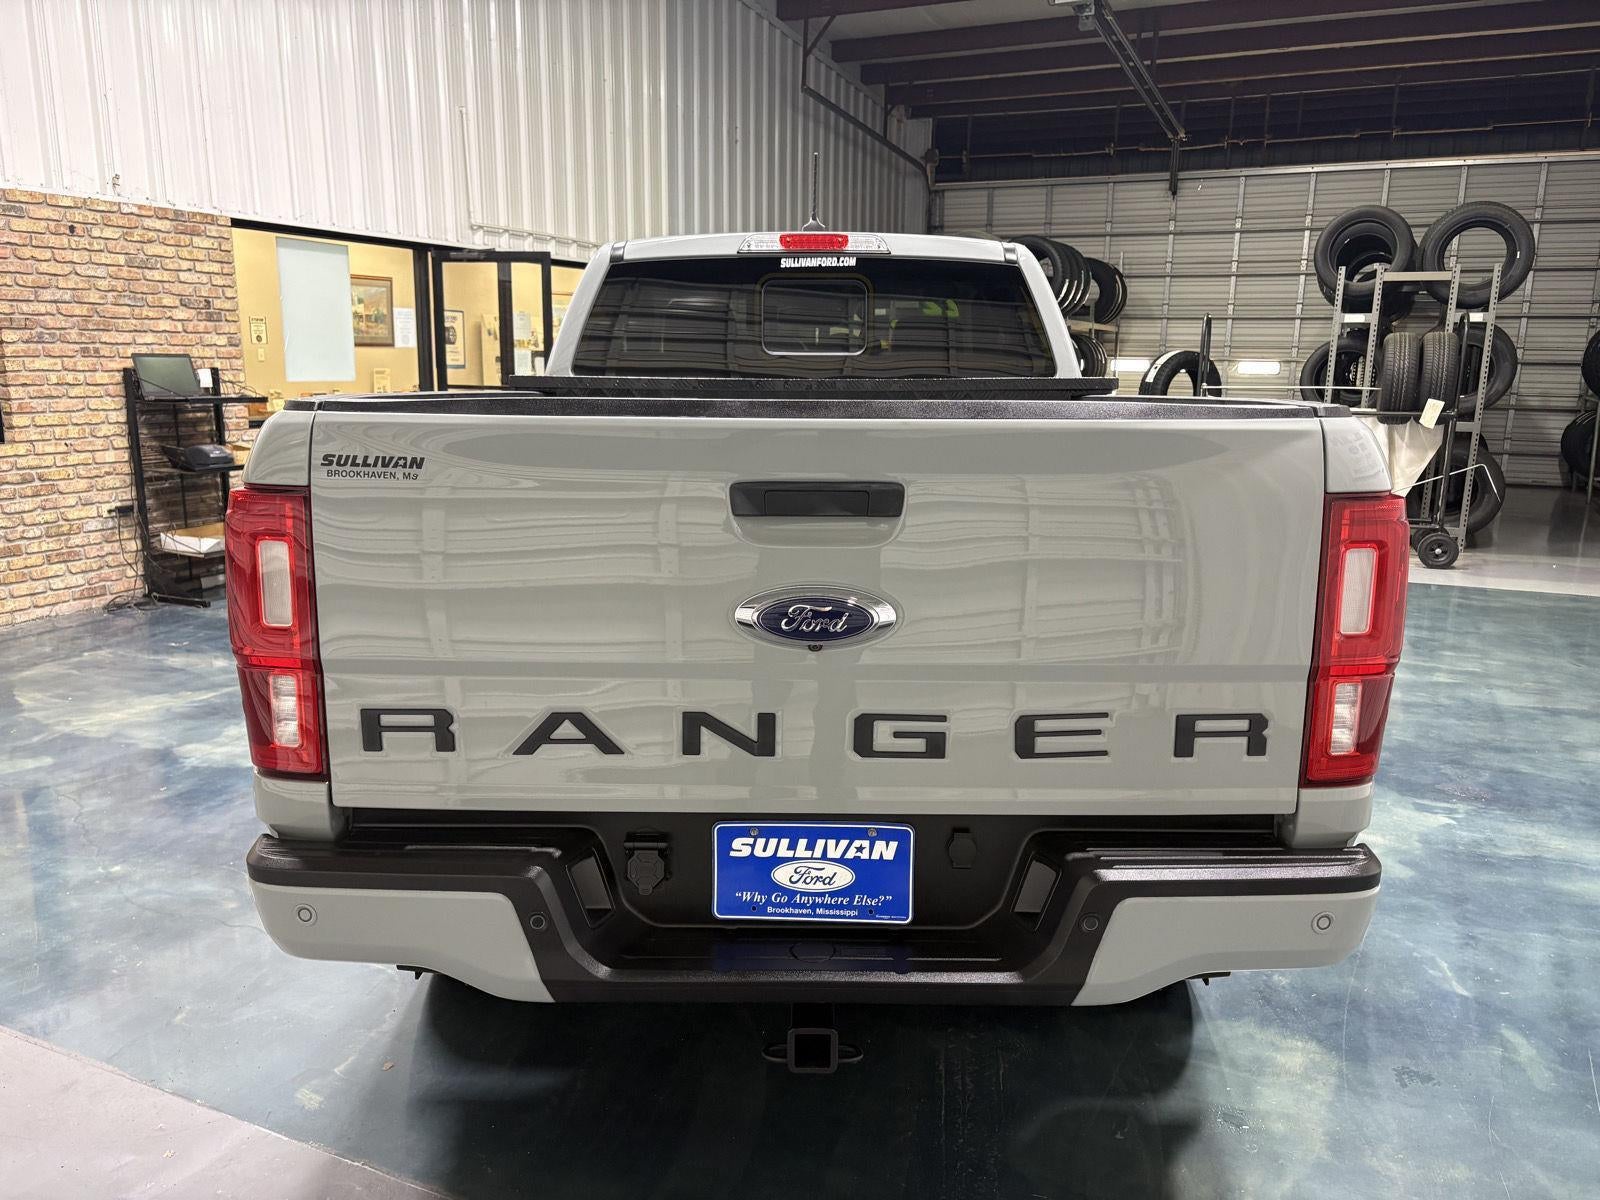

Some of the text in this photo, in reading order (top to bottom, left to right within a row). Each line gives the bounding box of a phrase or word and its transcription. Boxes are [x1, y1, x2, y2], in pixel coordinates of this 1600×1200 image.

[780, 257, 857, 268] SULLIVANFORD.COM
[320, 453, 425, 470] SULLIVAN
[326, 469, 400, 480] BROOKHAVEN,
[780, 604, 850, 633] Ford
[360, 708, 1269, 759] RANGER
[729, 837, 898, 861] SULLIVAN
[788, 865, 838, 886] Ford
[771, 892, 788, 903] Go
[791, 893, 850, 906] Anywhere
[767, 906, 858, 916] Brookhaven, Mississippi
